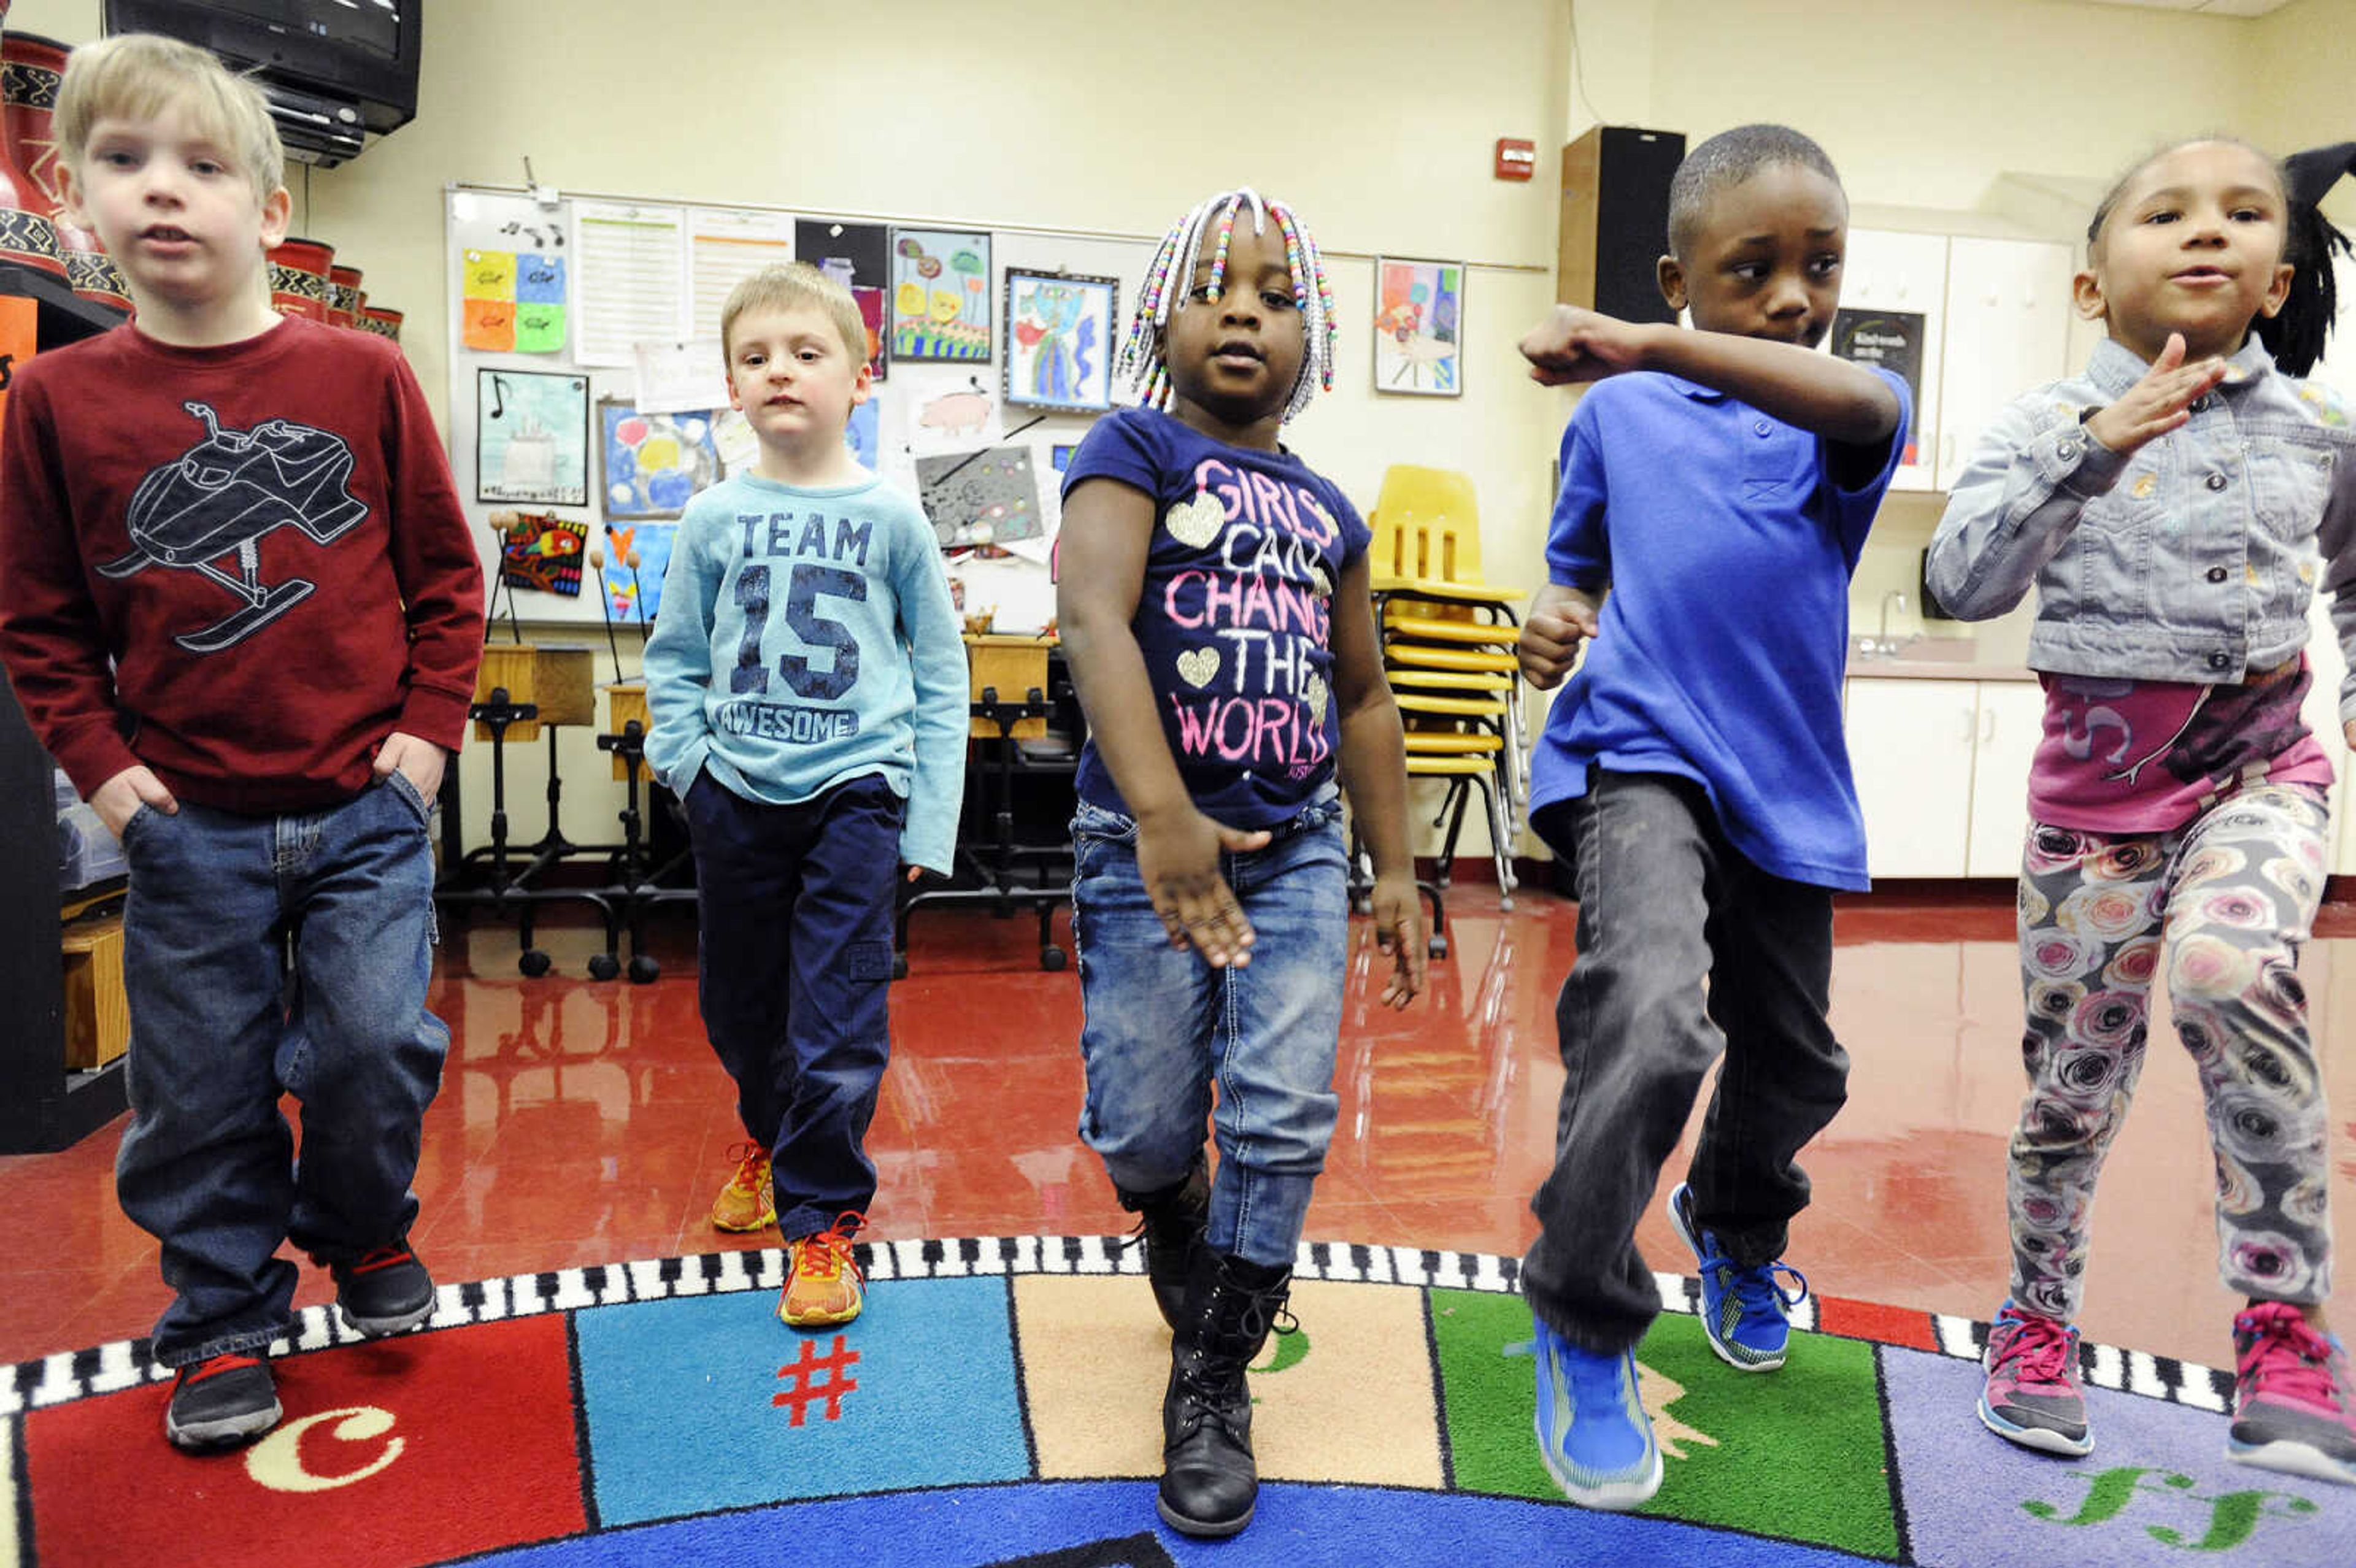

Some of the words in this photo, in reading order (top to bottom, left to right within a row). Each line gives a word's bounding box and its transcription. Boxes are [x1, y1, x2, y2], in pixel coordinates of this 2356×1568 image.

[737, 512, 872, 566] TEAM
[1194, 459, 1333, 548] GIRLS
[1221, 523, 1321, 581] CAN
[730, 563, 868, 701] 15
[1165, 570, 1330, 652] CHANG
[1215, 628, 1315, 702] THE
[720, 703, 850, 743] AWESOME
[1169, 691, 1330, 765] WORLD
